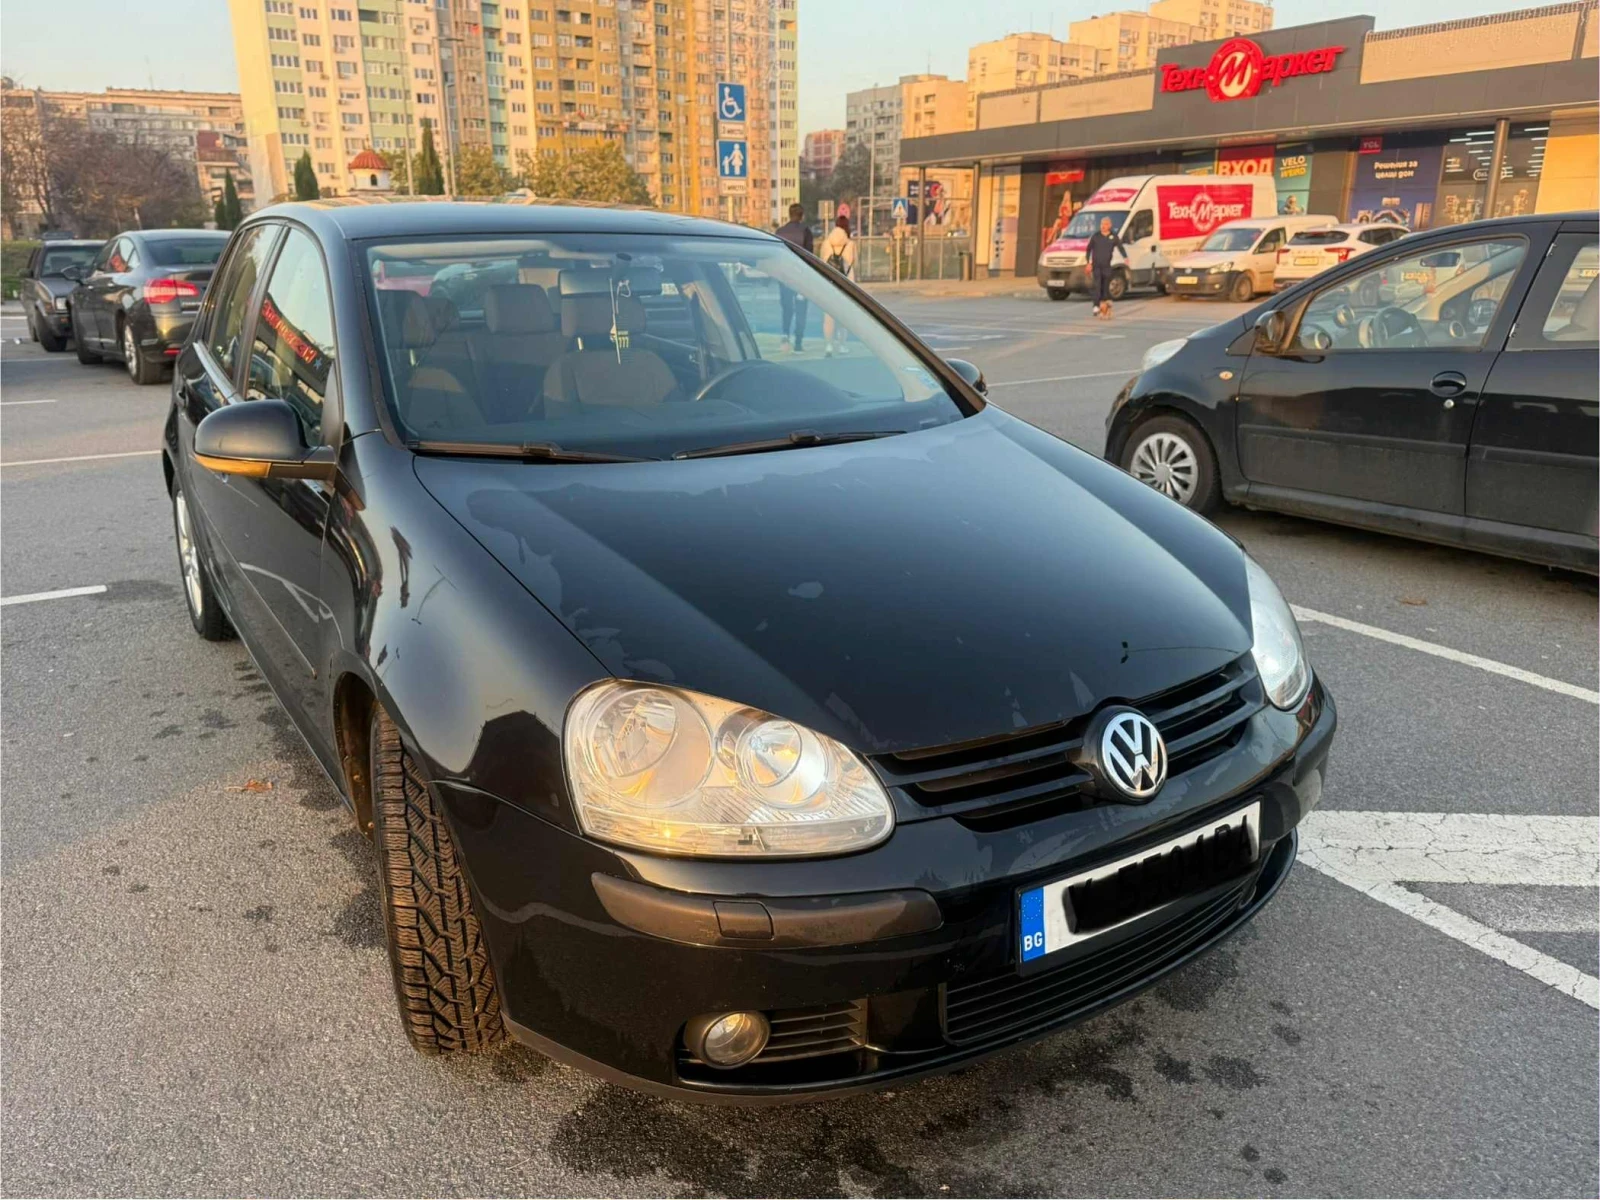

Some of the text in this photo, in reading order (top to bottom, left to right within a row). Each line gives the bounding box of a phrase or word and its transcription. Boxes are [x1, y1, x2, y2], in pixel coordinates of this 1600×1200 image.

[1219, 158, 1273, 176] ВХОД
[1281, 155, 1305, 167] VELO
[1024, 932, 1043, 951] BG
